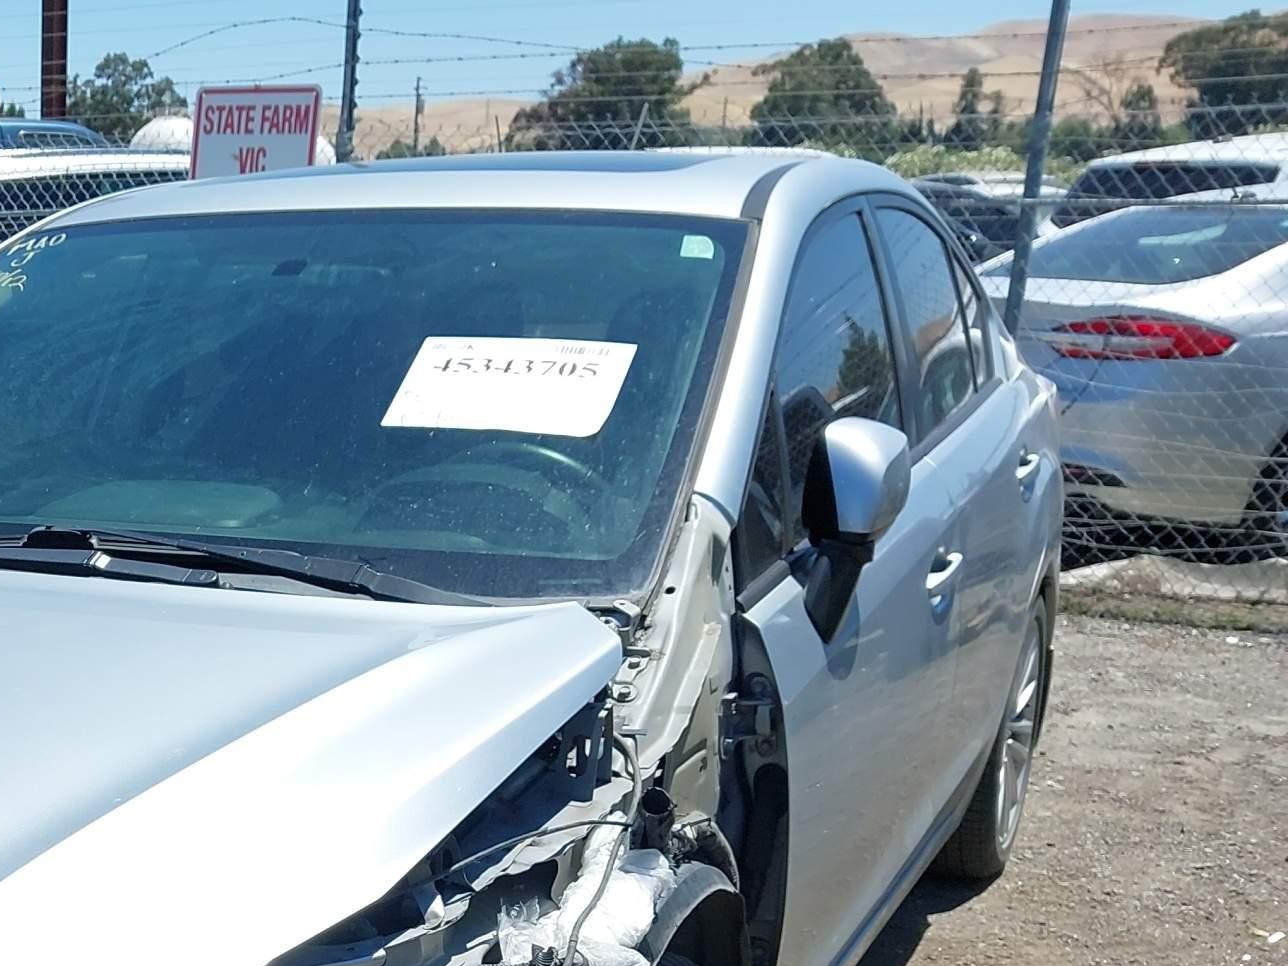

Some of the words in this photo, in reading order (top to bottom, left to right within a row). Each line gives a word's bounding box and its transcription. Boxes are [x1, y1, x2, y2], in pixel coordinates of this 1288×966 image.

[203, 104, 256, 135] STATE
[259, 104, 312, 135] FARM
[238, 147, 267, 175] VIC
[433, 357, 600, 378] 45343705
